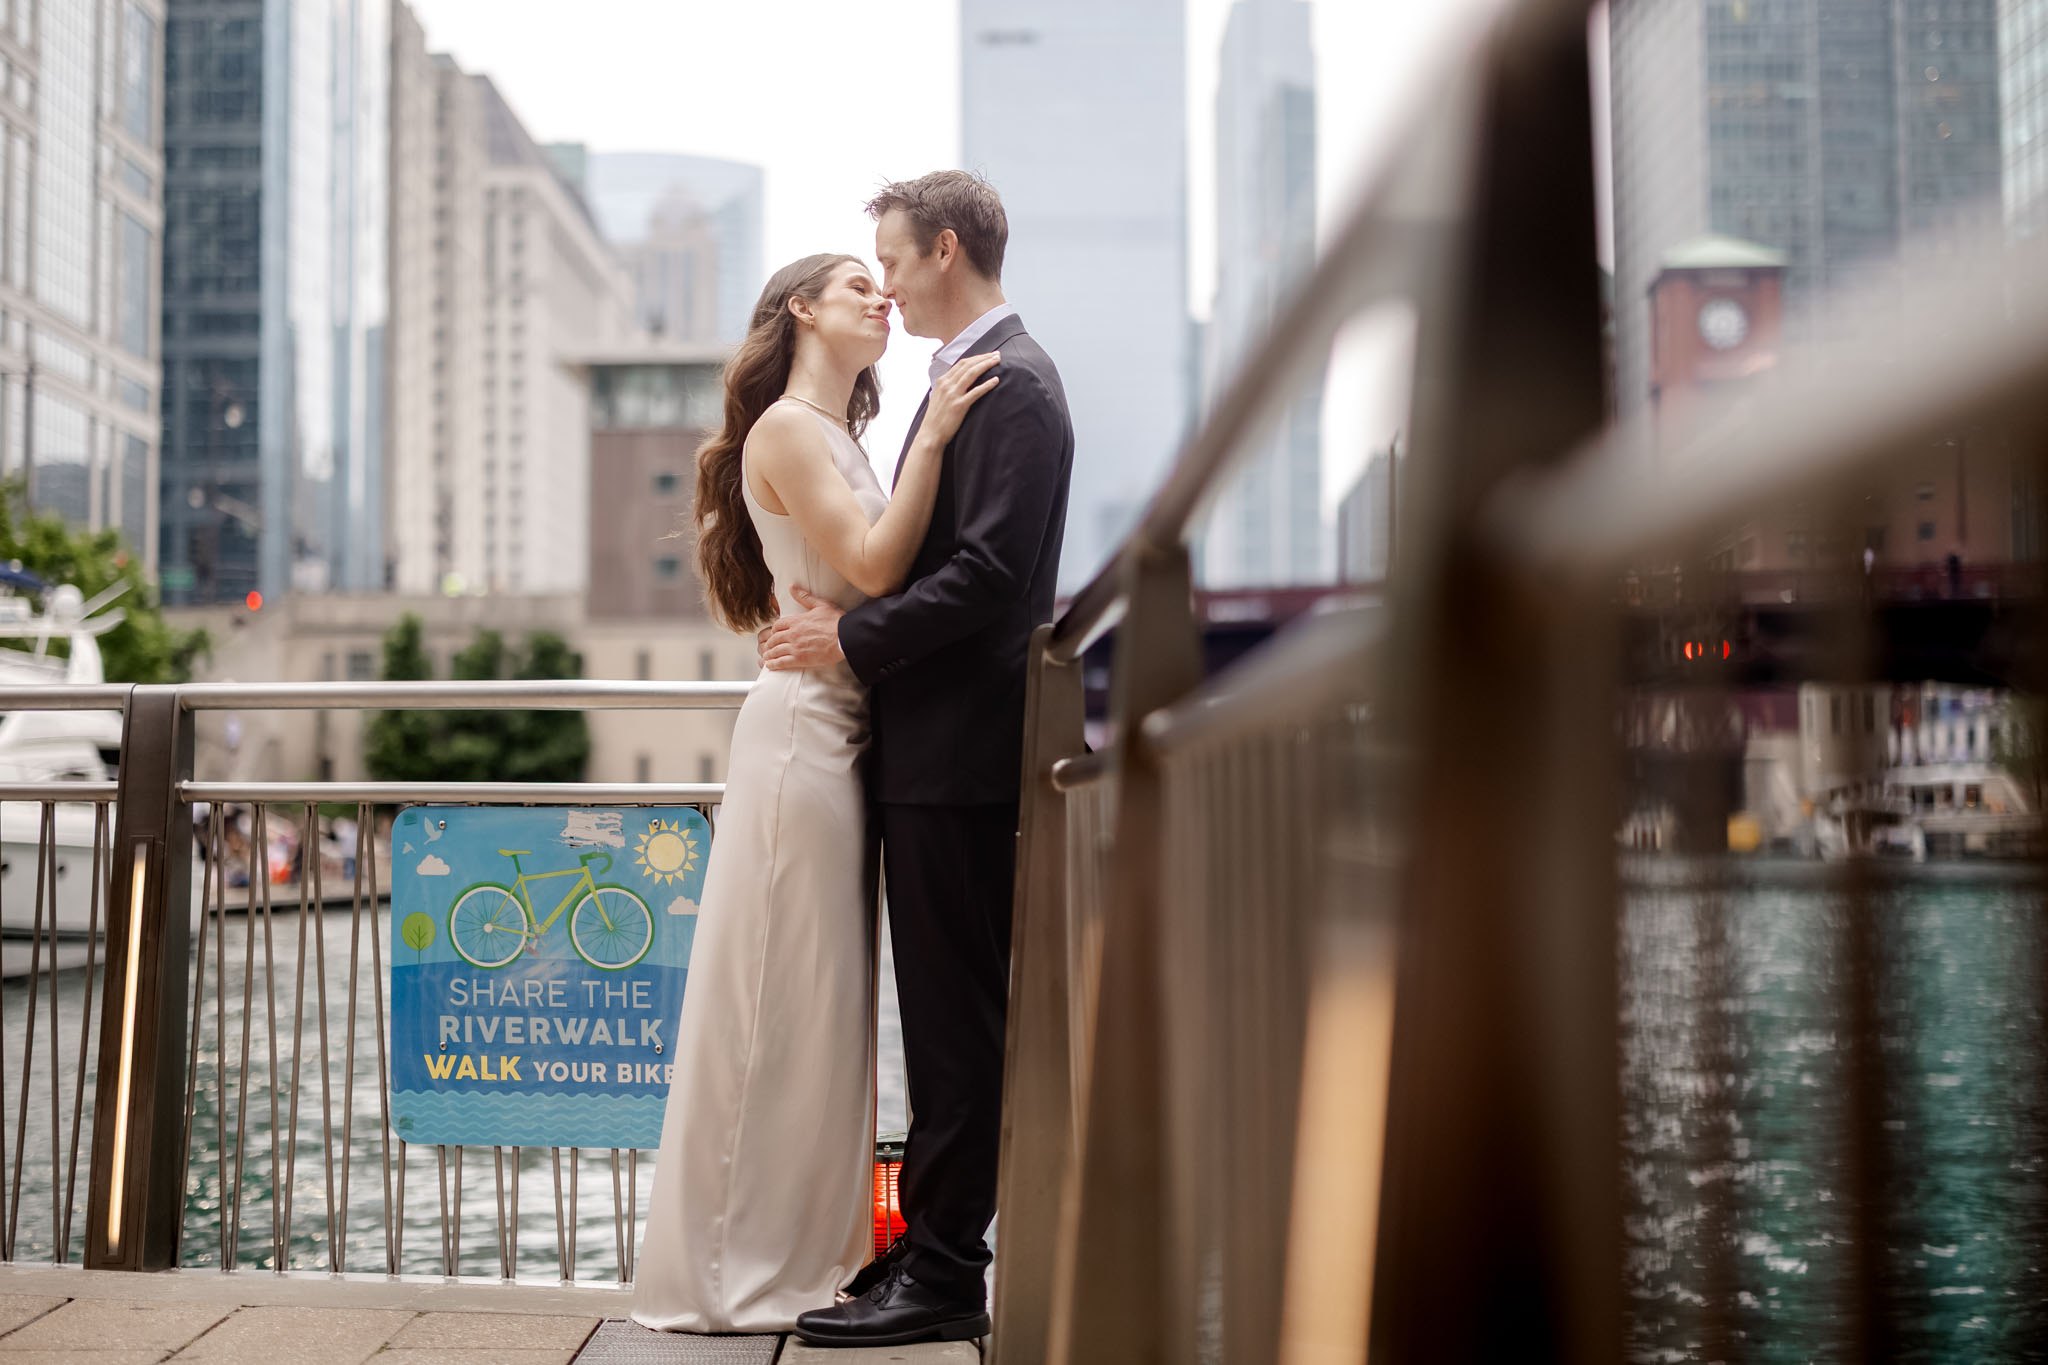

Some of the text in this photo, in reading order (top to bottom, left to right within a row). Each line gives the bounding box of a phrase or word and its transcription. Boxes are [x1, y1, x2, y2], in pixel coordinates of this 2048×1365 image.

[450, 978, 652, 1009] SHARE THE
[439, 1015, 664, 1047] RIVERWALK
[424, 1054, 522, 1081] WALK
[533, 1061, 607, 1082] YOUR
